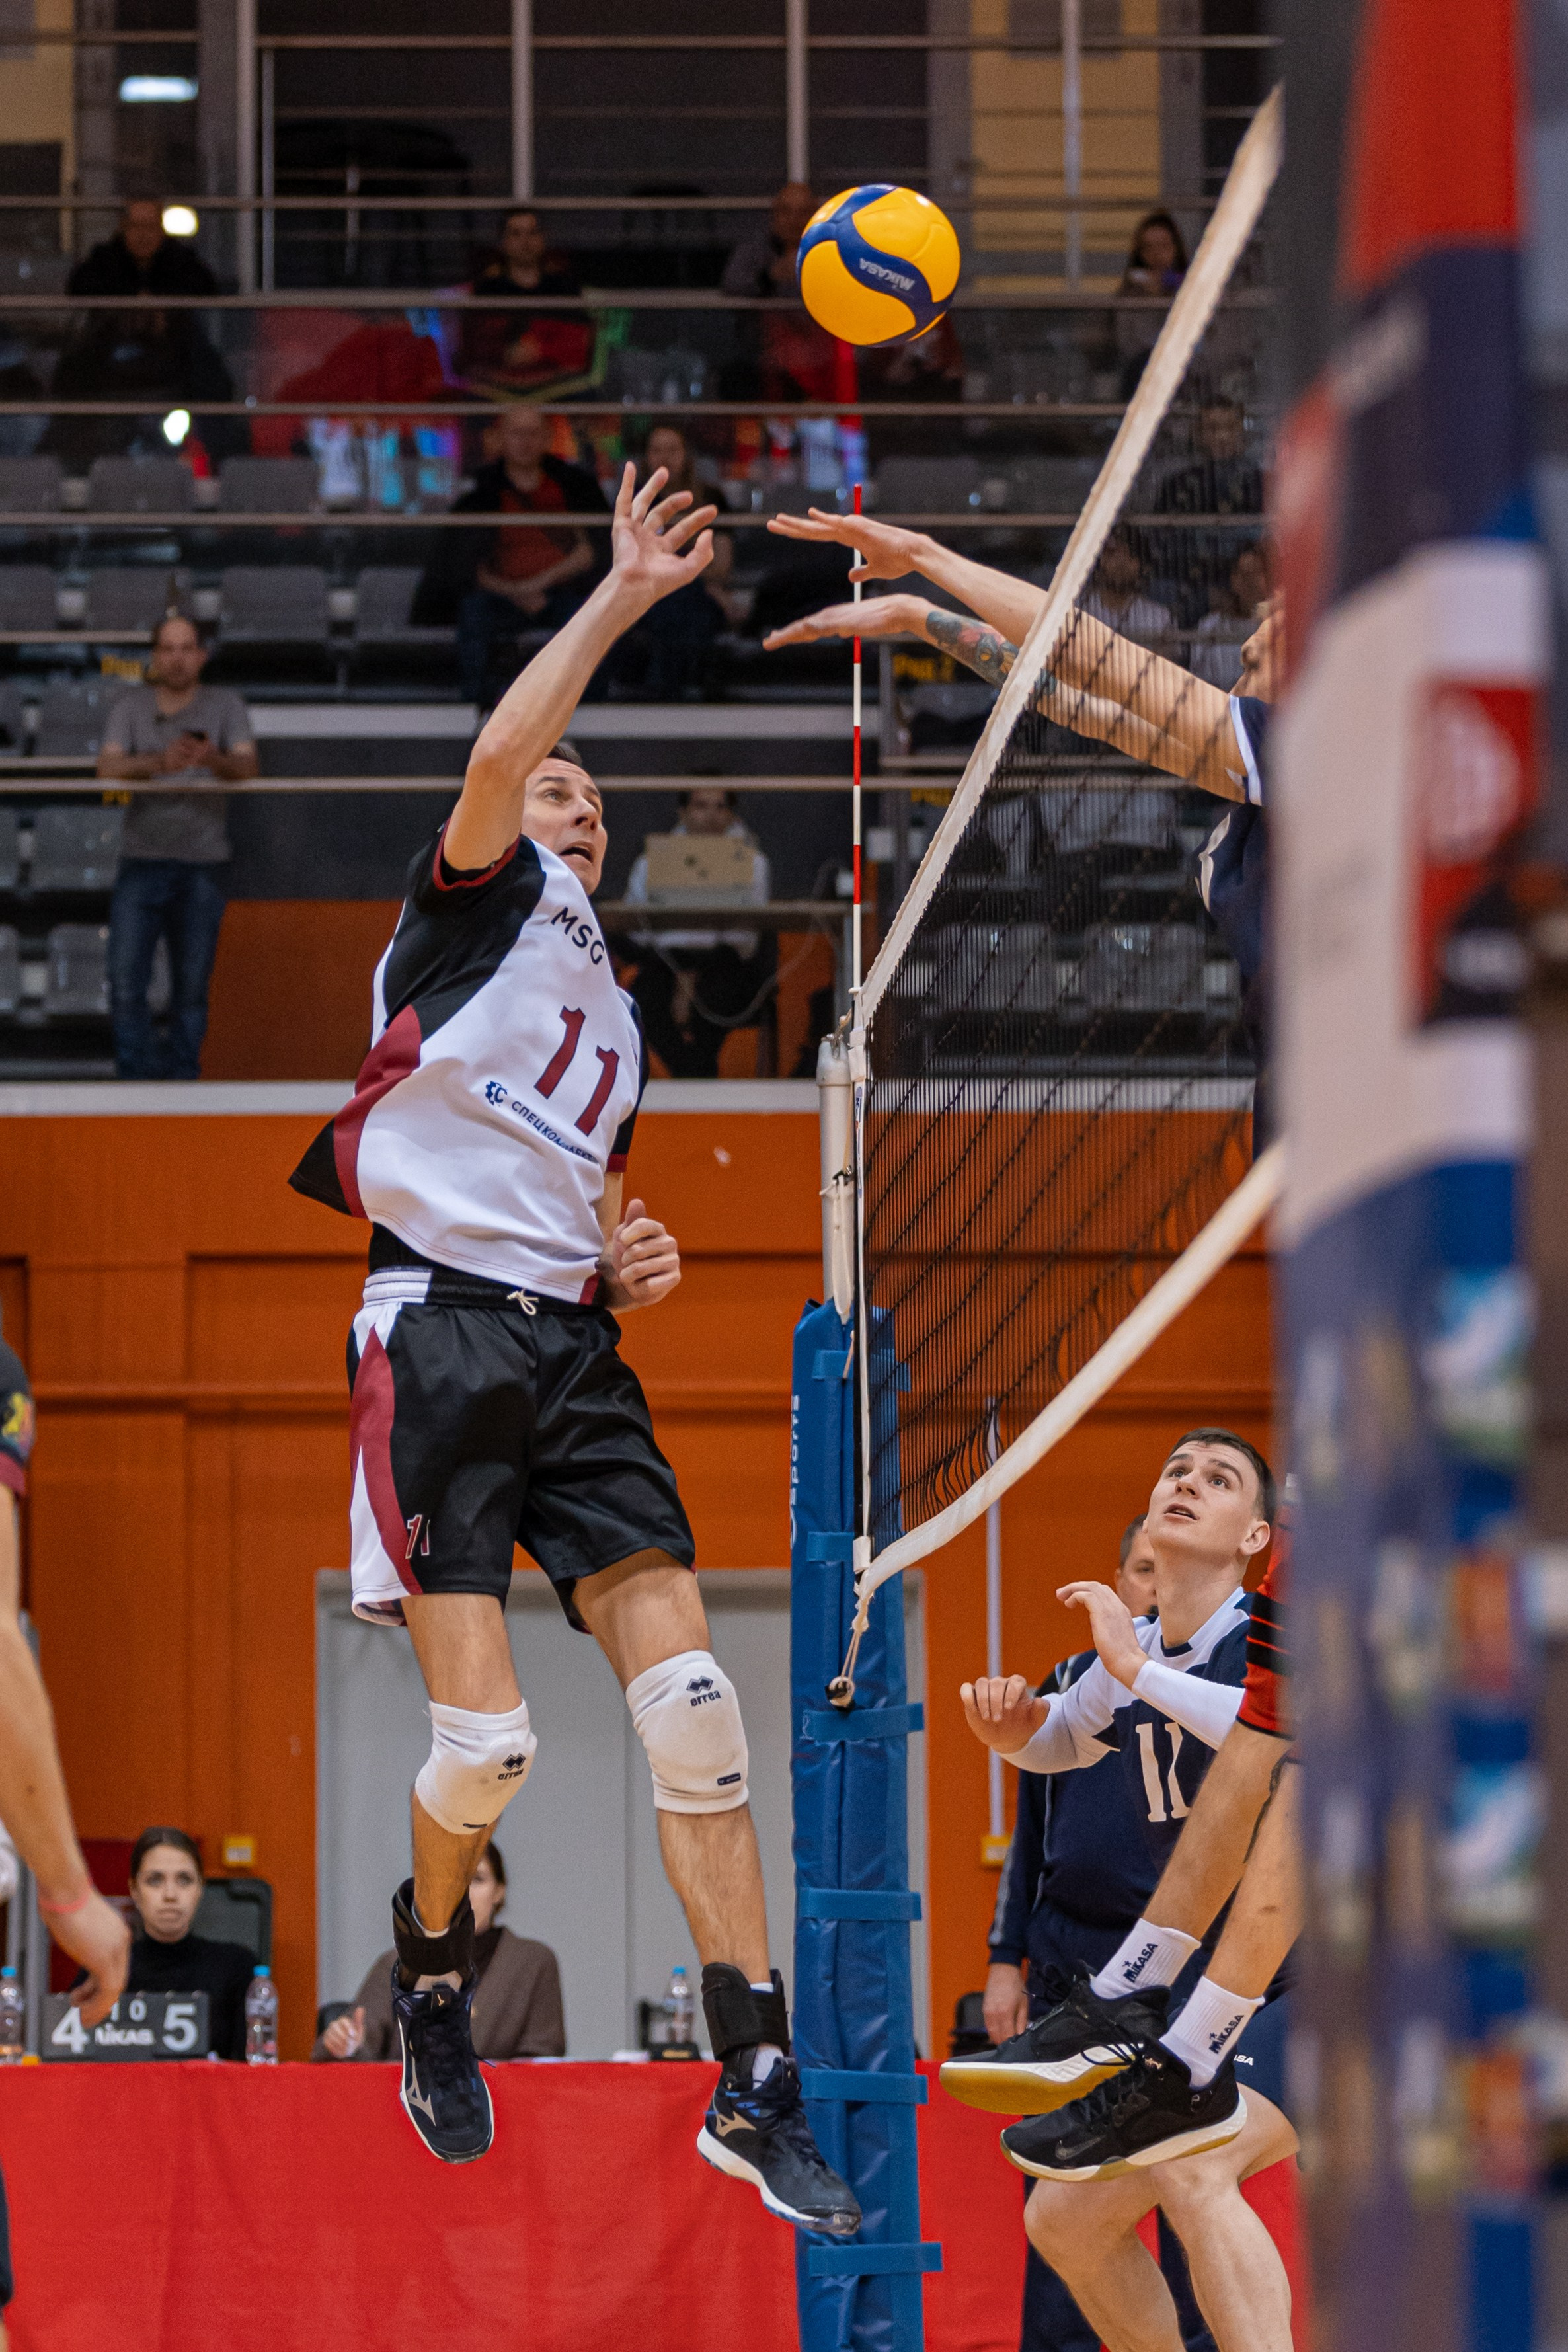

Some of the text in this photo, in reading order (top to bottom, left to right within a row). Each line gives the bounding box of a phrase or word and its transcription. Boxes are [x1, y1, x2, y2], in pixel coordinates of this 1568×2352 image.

[860, 258, 915, 290] MIKASA
[551, 906, 604, 965] MSG
[534, 1005, 619, 1137] 11
[690, 1690, 721, 1706] errea
[1123, 1943, 1158, 1983] MIKASA
[52, 2006, 89, 2054] 4
[162, 2002, 198, 2052] 5
[1208, 2015, 1244, 2054] MIKASA
